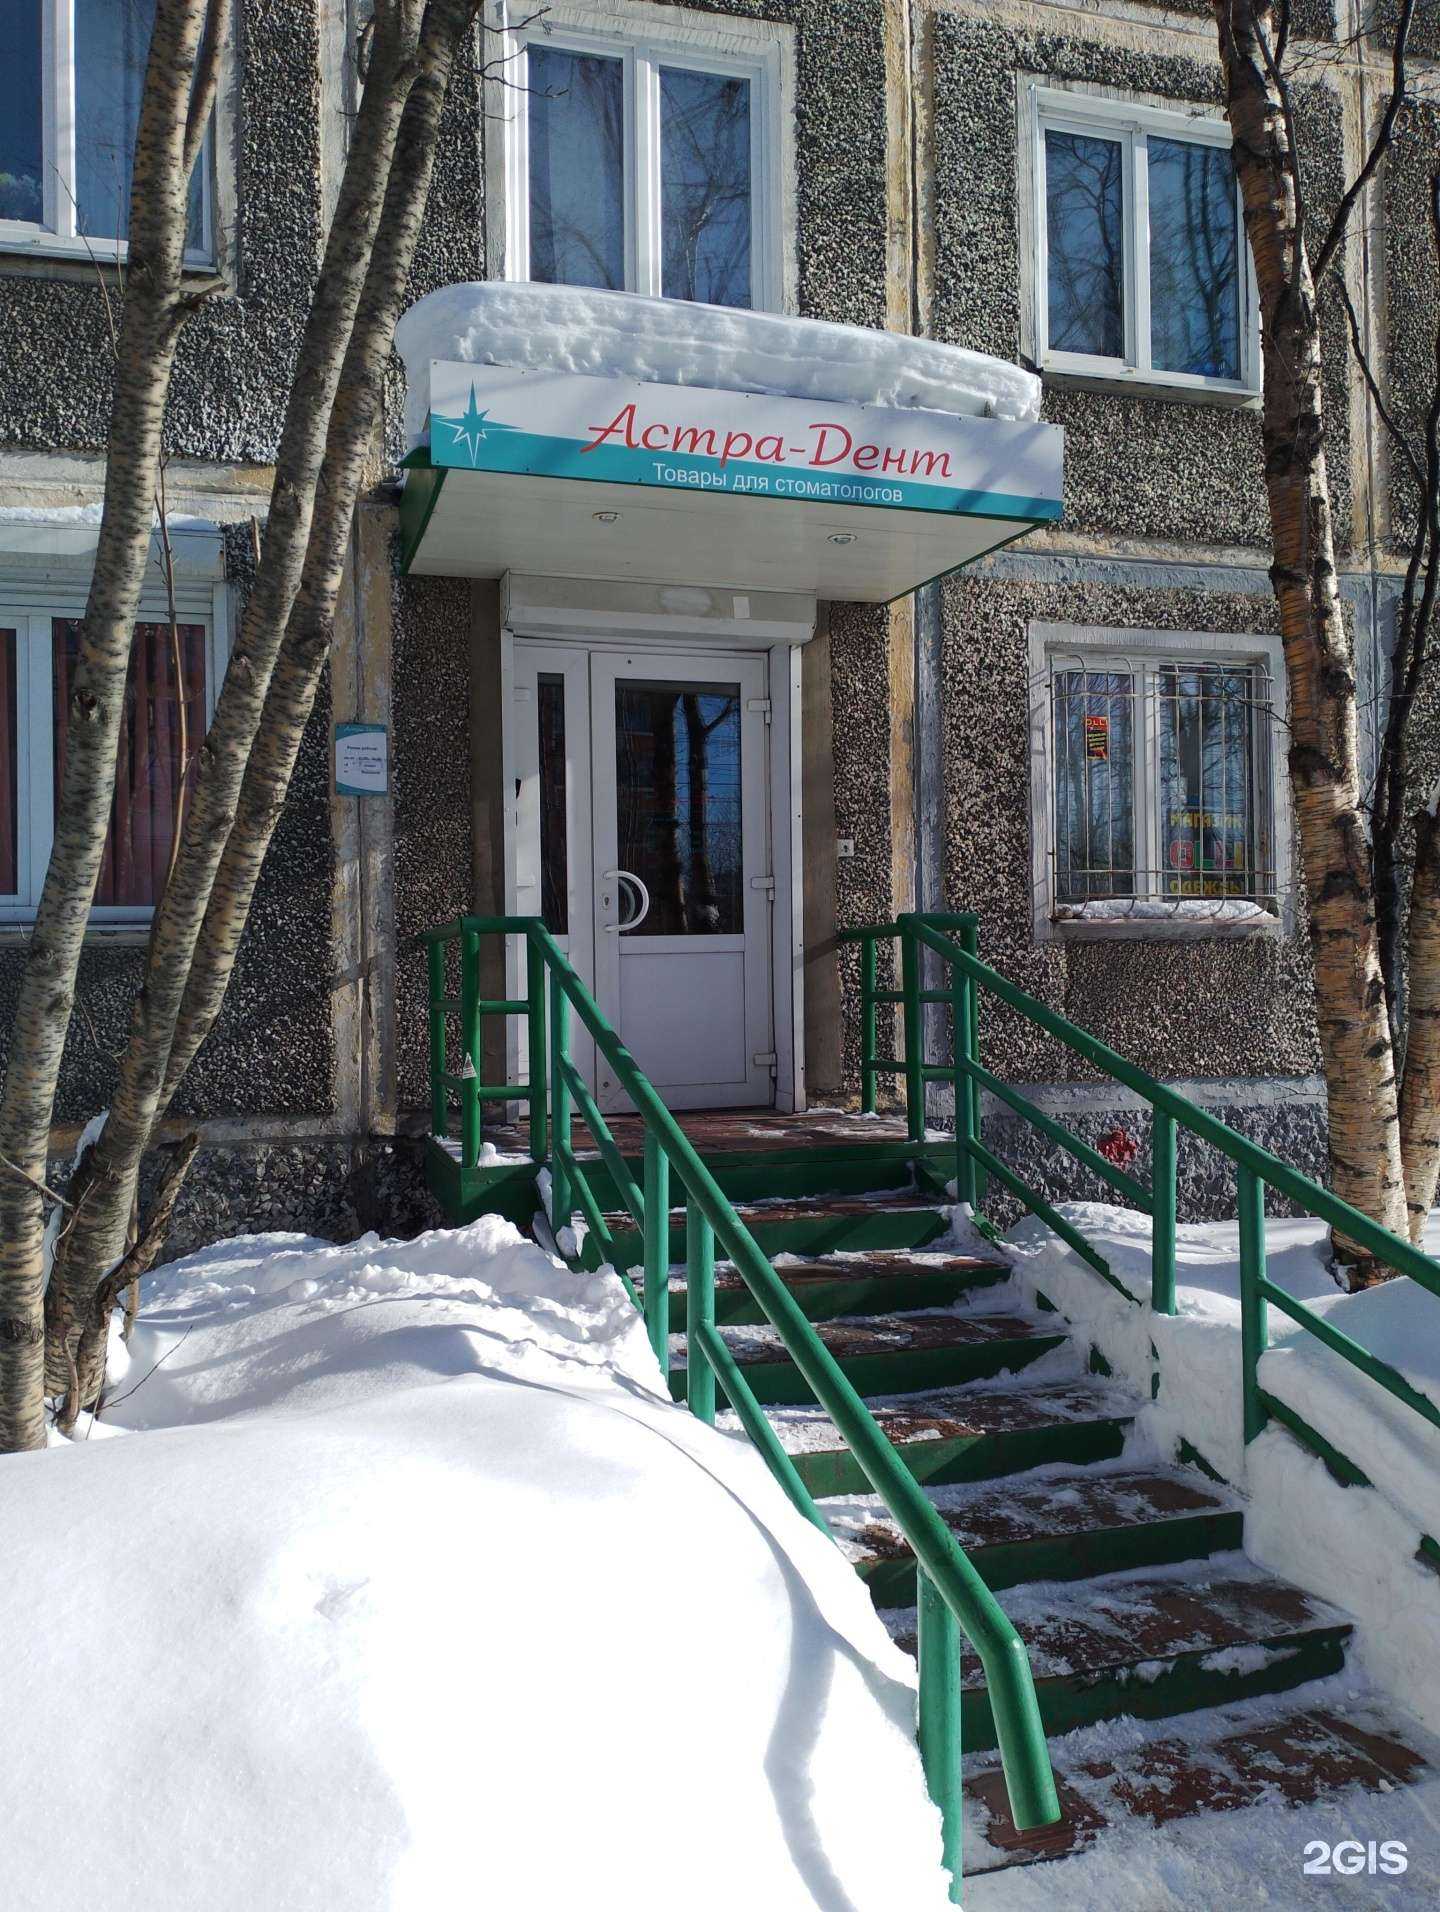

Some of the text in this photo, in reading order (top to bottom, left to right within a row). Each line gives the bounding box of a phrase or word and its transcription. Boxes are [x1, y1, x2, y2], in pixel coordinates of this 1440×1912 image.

[580, 403, 953, 478] Астра-Дент
[652, 463, 904, 503] Товары для стоматологов
